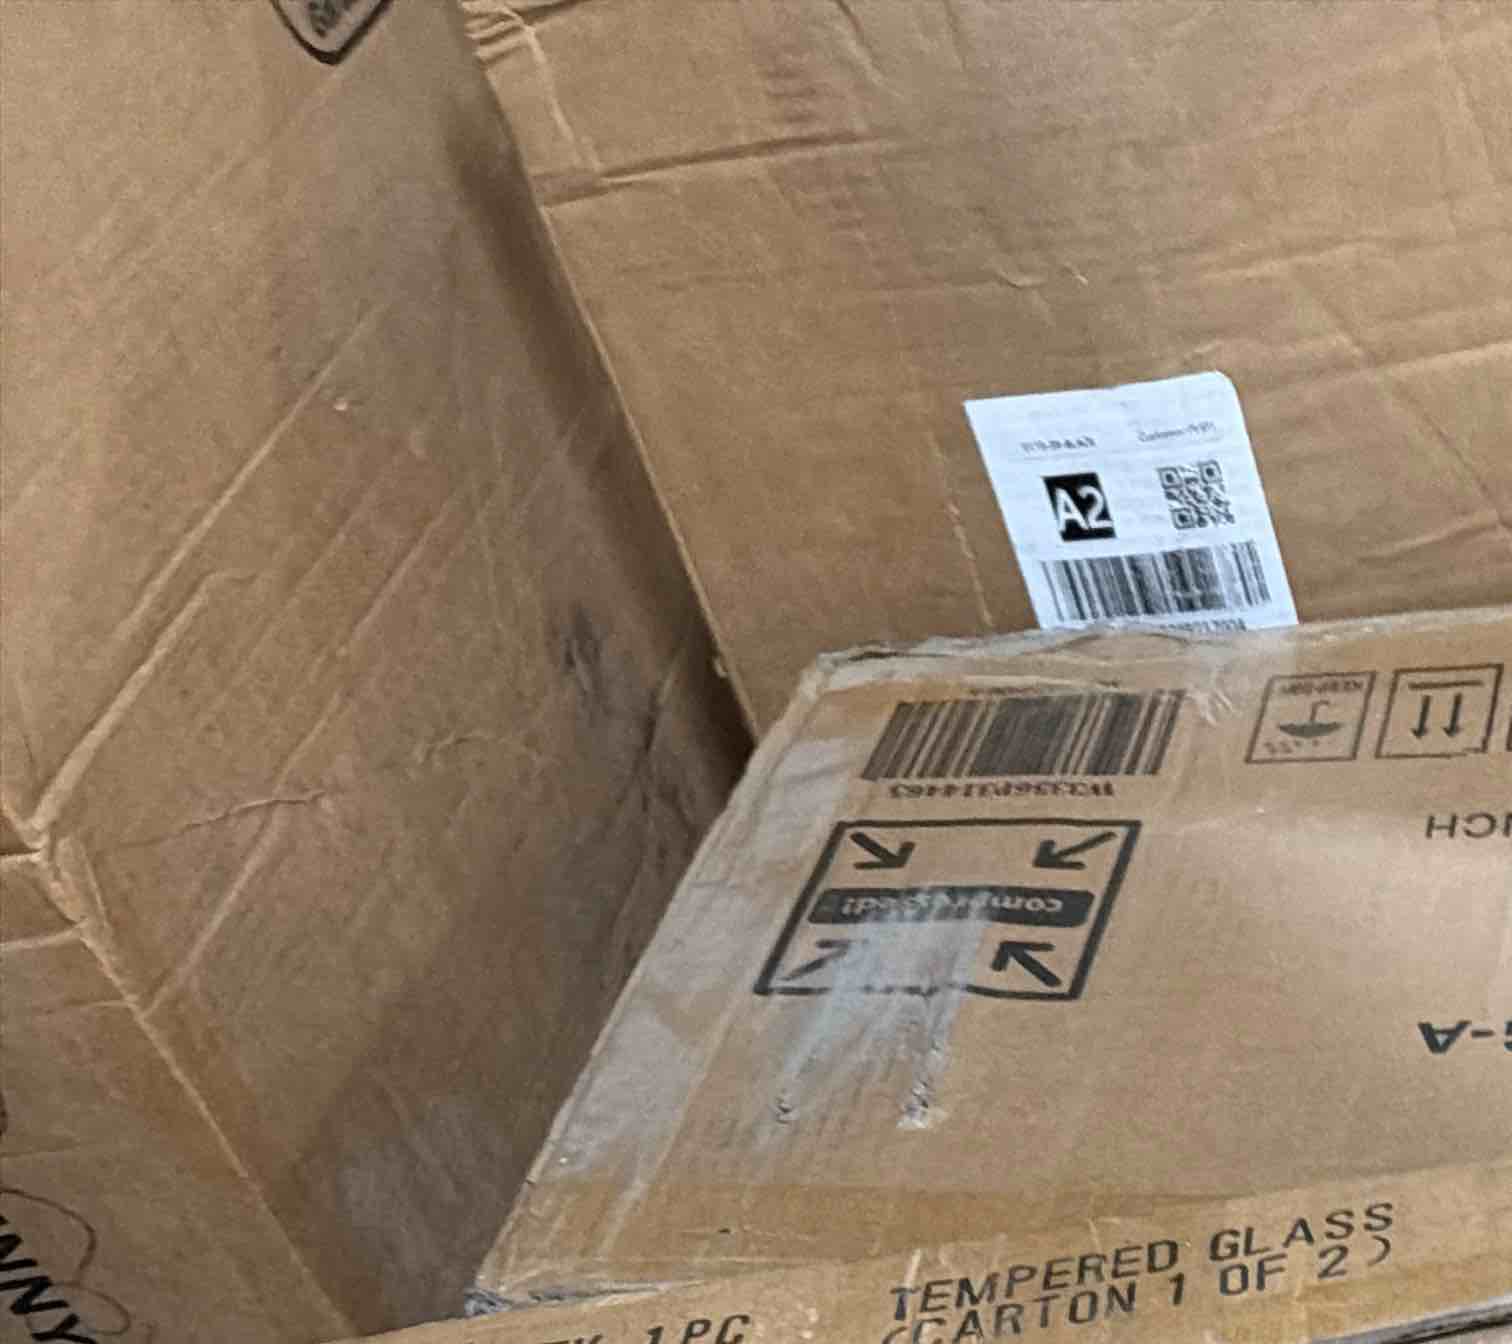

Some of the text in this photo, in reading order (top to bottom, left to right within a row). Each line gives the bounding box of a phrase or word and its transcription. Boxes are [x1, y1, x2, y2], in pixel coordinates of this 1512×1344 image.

[1055, 484, 1113, 533] A2
[889, 1202, 1394, 1321] TEMPERED GLASS
[1168, 1272, 1187, 1306] 1
[1218, 1253, 1286, 1297] OF
